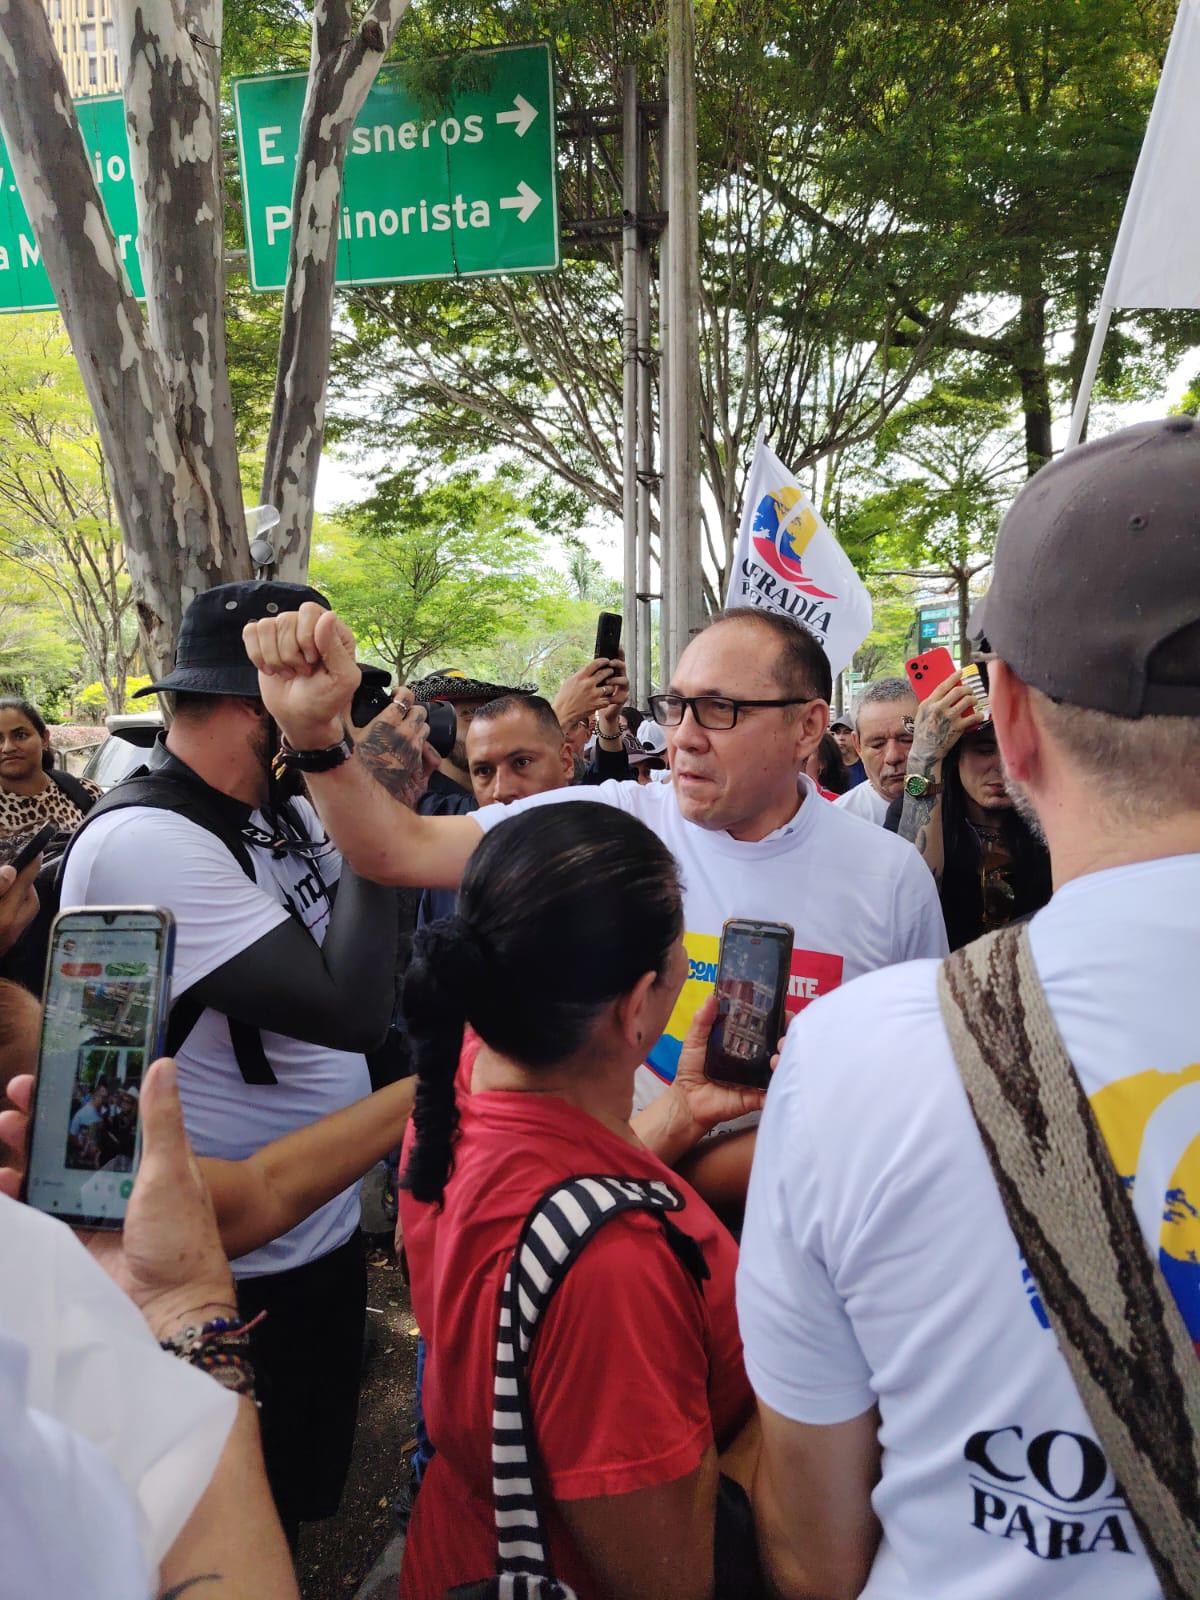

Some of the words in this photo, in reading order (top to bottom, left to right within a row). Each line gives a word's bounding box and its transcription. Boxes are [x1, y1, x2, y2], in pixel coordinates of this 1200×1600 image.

[352, 114, 484, 155] sneros
[337, 194, 490, 240] inorista
[964, 1425, 1110, 1503] CO
[969, 1483, 1137, 1560] PARA
